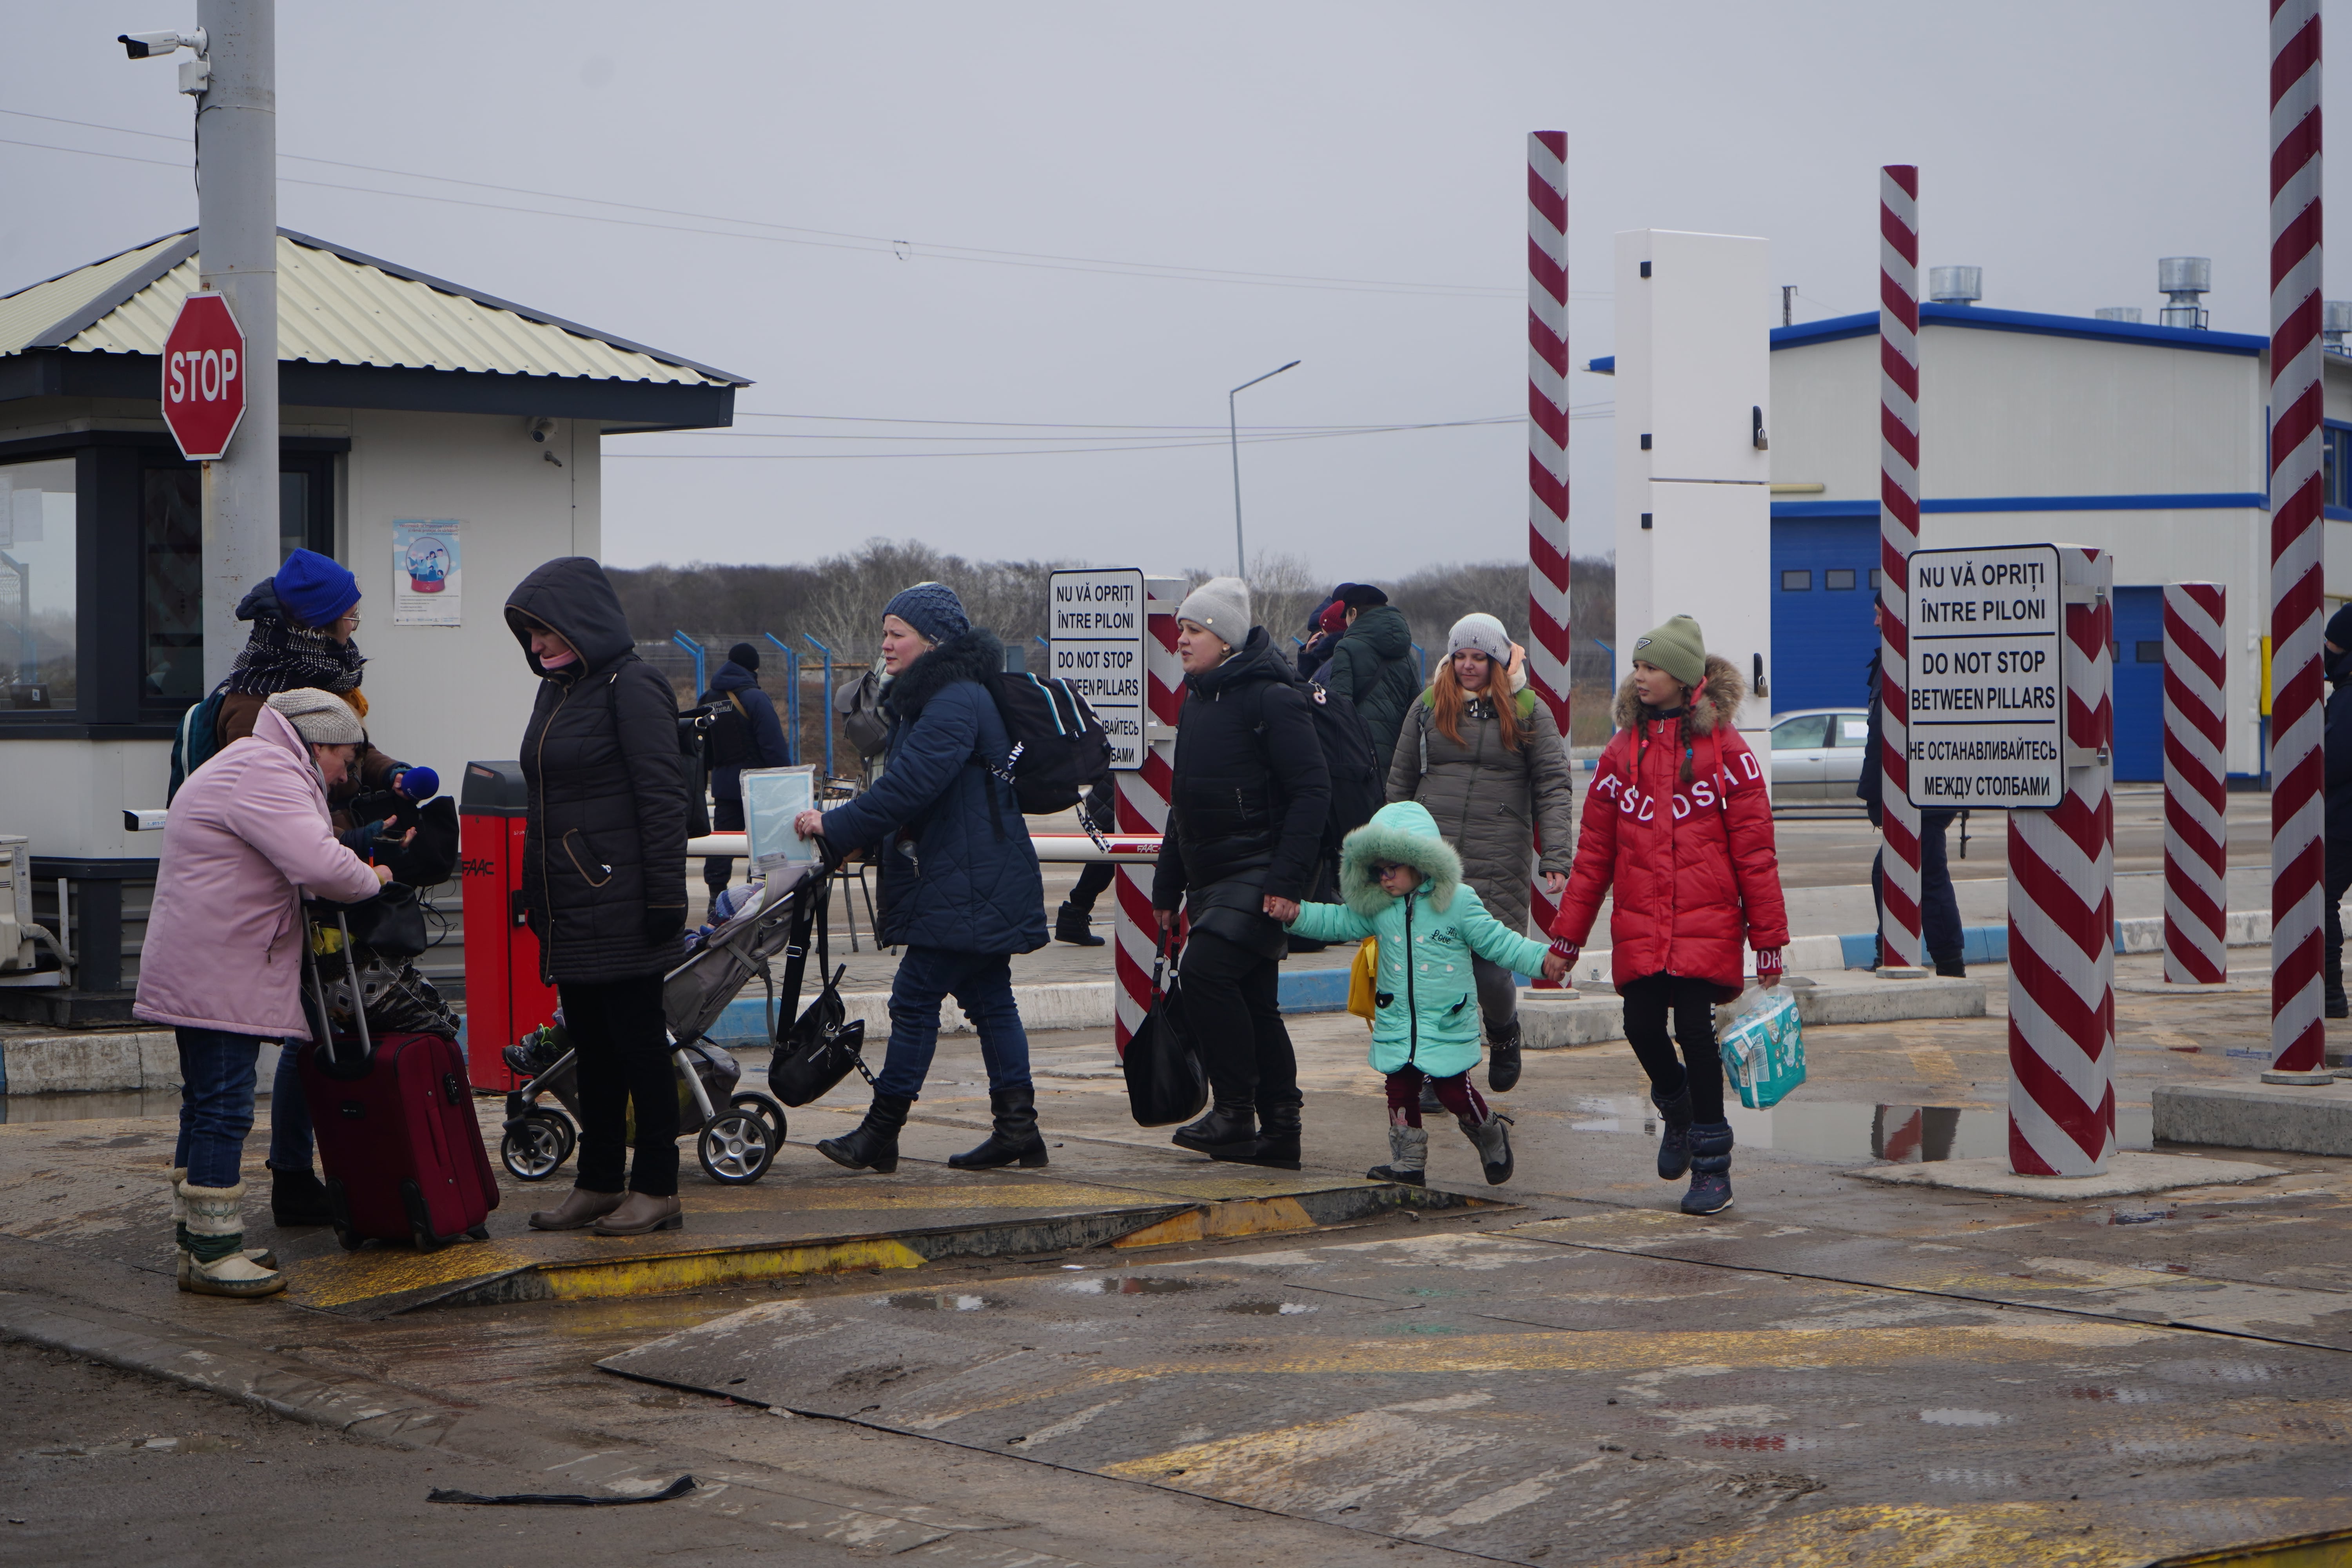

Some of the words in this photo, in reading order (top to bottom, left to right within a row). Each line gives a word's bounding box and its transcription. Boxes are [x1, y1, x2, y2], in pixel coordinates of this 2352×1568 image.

[170, 349, 237, 403] STOP
[1920, 567, 1944, 588] NU
[1950, 561, 1976, 586] VĂ
[1982, 563, 2044, 592] OPRIȚI
[1057, 586, 1072, 602] NU
[1076, 582, 1092, 602] VĂ
[1095, 585, 1133, 608] OPRIȚI
[1058, 610, 1091, 629] ÎNTRE
[1095, 613, 1133, 628] PILONI
[1921, 598, 1976, 622] ÎNTRE
[1983, 599, 2045, 621] PILONI
[1058, 652, 1074, 668] DO
[1077, 652, 1100, 668] NOT
[1103, 651, 1133, 668] STOP
[1923, 653, 1948, 675] DO
[1955, 652, 1992, 674] NOT
[1997, 651, 2045, 673] STOP
[1097, 679, 1138, 696] PILLARS
[1912, 688, 1983, 710] BETWEEN
[1987, 686, 2055, 709] PILLARS
[1111, 746, 1134, 762] БАМИ
[1909, 741, 1924, 760] НЕ
[1928, 737, 2057, 760] ОСТАНАВЛИВАЙТЕСЬ
[1925, 777, 1972, 799] МЕЖДУ
[1976, 776, 2050, 796] СТОЛБАМИ
[1137, 844, 1158, 853] FAAC
[462, 858, 494, 877] FAAC
[1429, 929, 1451, 944] Love
